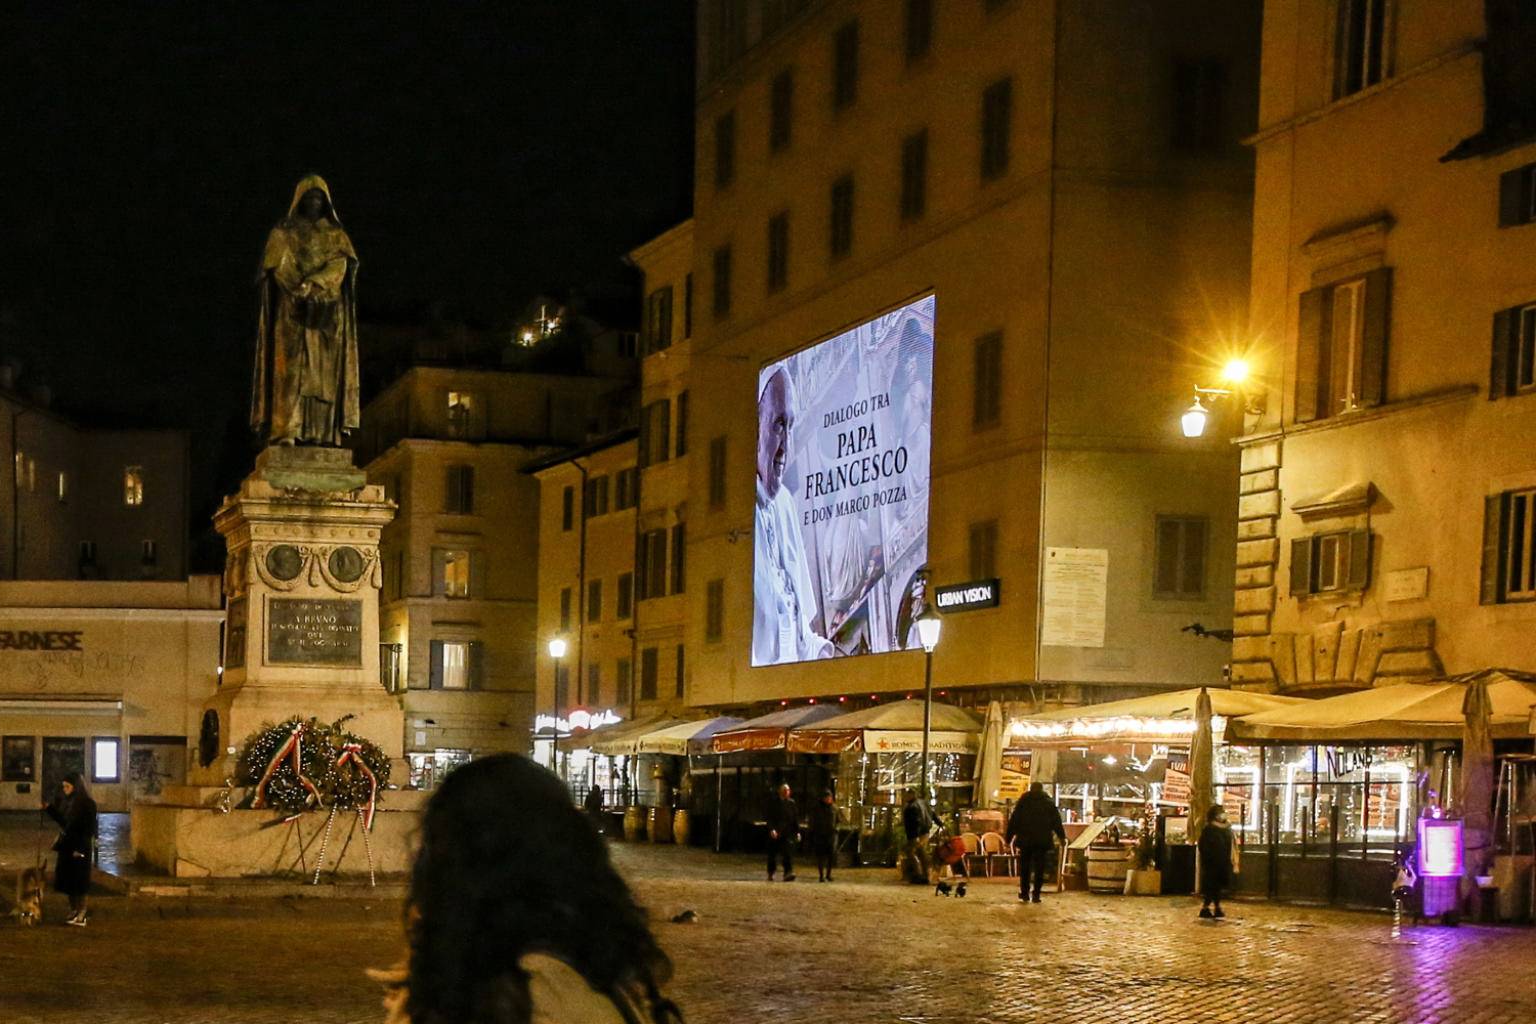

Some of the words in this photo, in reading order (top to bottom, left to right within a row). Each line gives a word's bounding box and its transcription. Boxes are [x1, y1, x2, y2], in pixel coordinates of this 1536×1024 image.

[824, 399, 868, 428] DIALOGO
[871, 392, 890, 411] TRA
[837, 422, 877, 459] PAPA
[805, 446, 908, 500] FRANCESCO
[804, 511, 810, 526] E
[812, 505, 833, 524] DON
[835, 495, 870, 517] MARCO
[873, 486, 907, 508] POZZA
[937, 590, 964, 607] URBAN
[964, 586, 992, 603] VISION
